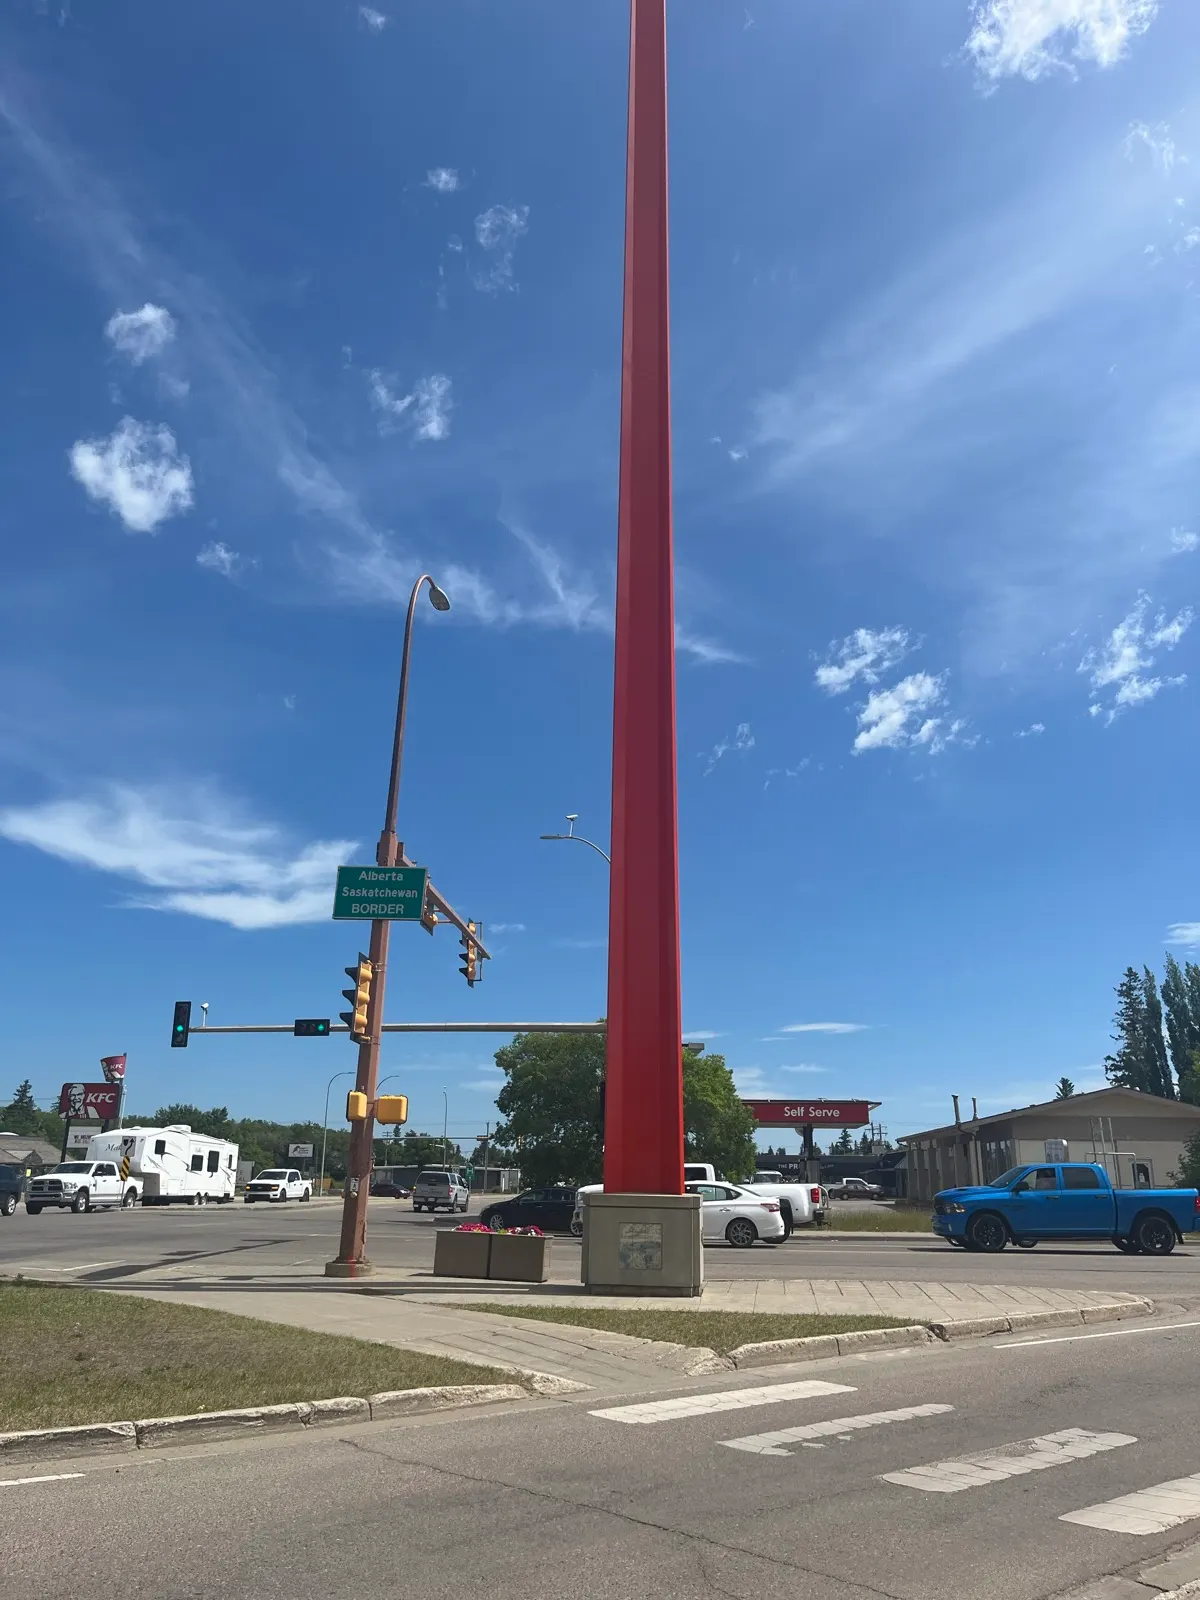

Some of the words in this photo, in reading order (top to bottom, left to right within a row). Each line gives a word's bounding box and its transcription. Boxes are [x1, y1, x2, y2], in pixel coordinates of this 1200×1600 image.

[358, 871, 403, 881] Alberta
[342, 887, 418, 898] Saskatchewan
[352, 903, 404, 914] BORDER
[86, 1092, 116, 1103] KFC
[784, 1106, 805, 1117] Self
[808, 1106, 840, 1117] Serve
